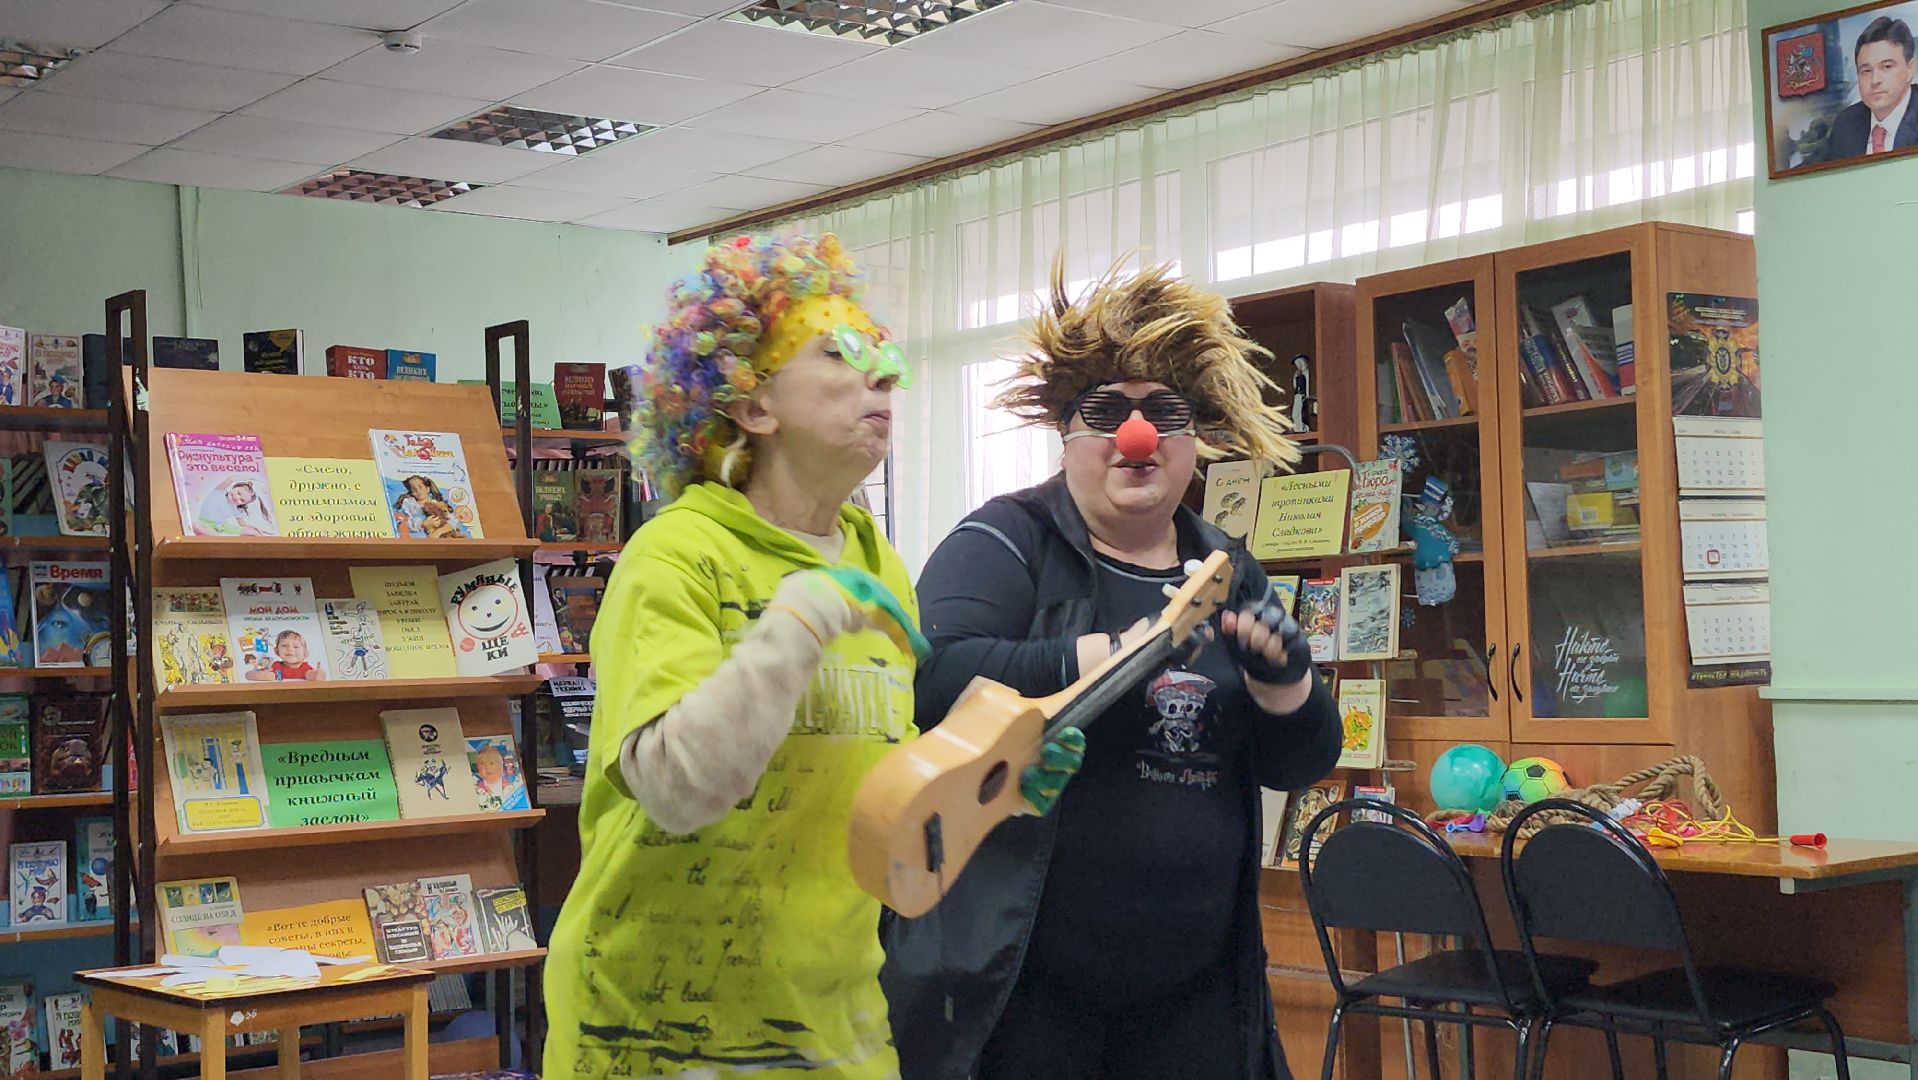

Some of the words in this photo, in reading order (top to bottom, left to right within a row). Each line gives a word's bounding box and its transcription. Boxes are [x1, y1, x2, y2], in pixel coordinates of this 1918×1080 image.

[347, 355, 375, 366] КТО
[347, 370, 375, 379] КТО
[187, 464, 208, 472] это
[296, 464, 352, 476] «Смело,
[290, 480, 351, 493] дружно,
[280, 498, 377, 507] оптимизмом
[289, 514, 304, 522] за
[308, 512, 376, 524] здоровый
[49, 565, 103, 580] Время
[451, 574, 518, 605] РУМЯНЫЕ
[275, 606, 299, 615] ДОМ
[278, 750, 369, 767] «Вредным
[275, 770, 381, 788] привычкам
[287, 787, 377, 806] книжный
[301, 812, 369, 827] заслон»
